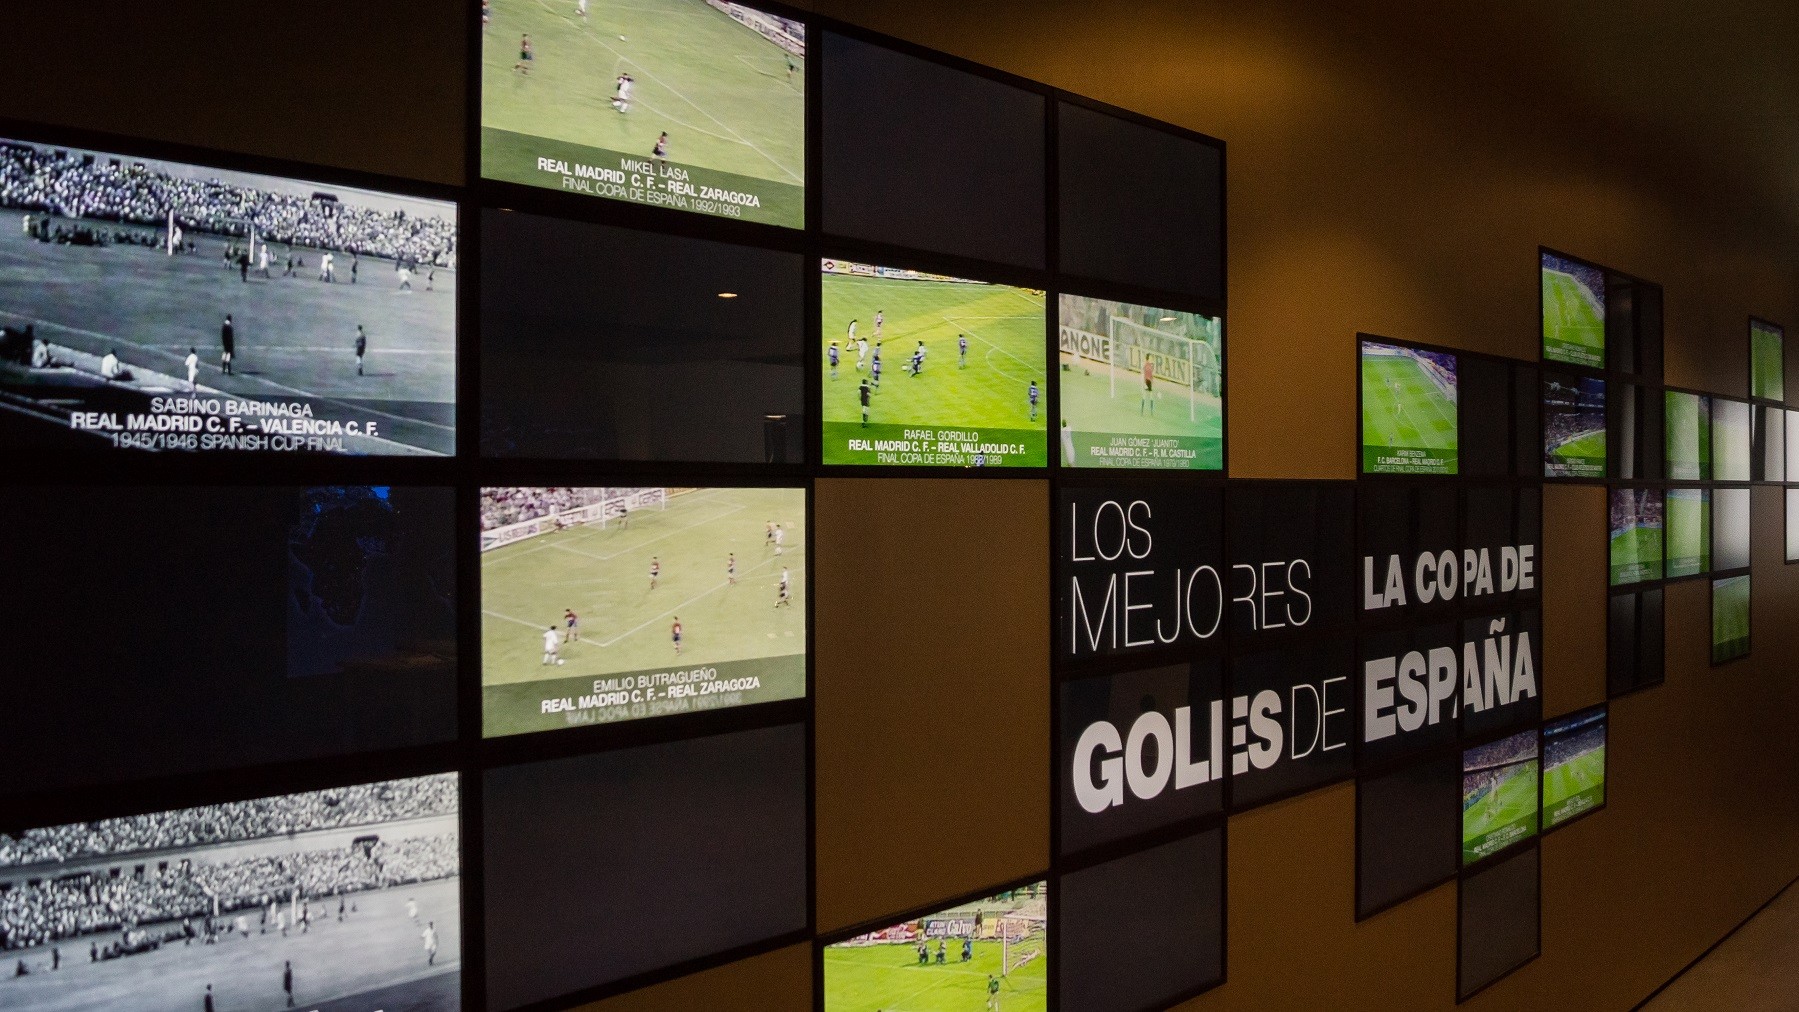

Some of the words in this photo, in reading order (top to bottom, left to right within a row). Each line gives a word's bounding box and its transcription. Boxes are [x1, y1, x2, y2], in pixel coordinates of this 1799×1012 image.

[537, 157, 572, 176] REAL
[575, 164, 625, 184] MADRID
[631, 175, 644, 188] C.
[646, 177, 656, 190] F.
[668, 182, 698, 197] REAL
[700, 186, 760, 208] ZARAGOZA
[621, 158, 654, 176] MIKEL
[660, 166, 689, 181] LASA
[562, 176, 594, 193] FINAL
[596, 182, 628, 199] COPA
[629, 188, 645, 201] DE
[647, 190, 688, 208] ESPAÑA
[690, 198, 741, 217] 1992/1993
[151, 397, 221, 415] SABINO
[225, 400, 313, 418] BARINAGA
[70, 411, 123, 430] REAL
[127, 413, 203, 432] MADRID
[206, 416, 226, 432] C.
[229, 417, 244, 433] F.
[260, 418, 343, 435] VALENCIA
[346, 420, 363, 436] C.
[366, 421, 379, 436] F.
[904, 429, 936, 441] RAFAEL
[937, 430, 979, 442] GORDILLO
[111, 432, 198, 450] 1945/1946
[200, 434, 269, 450] SPANISH
[271, 435, 305, 451] CUP
[307, 436, 348, 452] FINAL
[848, 439, 873, 451] REAL
[874, 440, 910, 452] MADRID
[912, 441, 921, 452] C.
[922, 441, 930, 452] F.
[937, 442, 960, 453] REAL
[960, 443, 1008, 454] VALLADOLID
[1009, 444, 1018, 454] C.
[1019, 444, 1026, 454] F.
[1090, 446, 1108, 456] REAL
[1109, 447, 1135, 456] MADRID
[1168, 449, 1197, 459] CASTILLA
[1110, 437, 1127, 447] JUAN
[1128, 436, 1150, 448] GÓMEZ
[877, 452, 900, 463] FINAL
[900, 452, 922, 464] COPA
[924, 453, 935, 464] DE
[935, 452, 965, 464] ESPAÑA
[1072, 500, 1152, 562] LOS
[1364, 554, 1406, 610] LA
[1415, 548, 1494, 604] COPA
[1501, 544, 1535, 593] DE
[1072, 559, 1312, 654] MEJORES
[593, 676, 635, 694] EMILIO
[637, 667, 717, 688] BUTRAGUEÑO
[1364, 617, 1538, 743] ESPAÑA
[541, 697, 577, 714] REAL
[578, 691, 629, 709] MADRID
[631, 689, 645, 703] C.
[646, 688, 656, 701] F.
[667, 684, 698, 699] REAL
[699, 676, 760, 695] ZARAGOZA
[1291, 676, 1348, 760] DE
